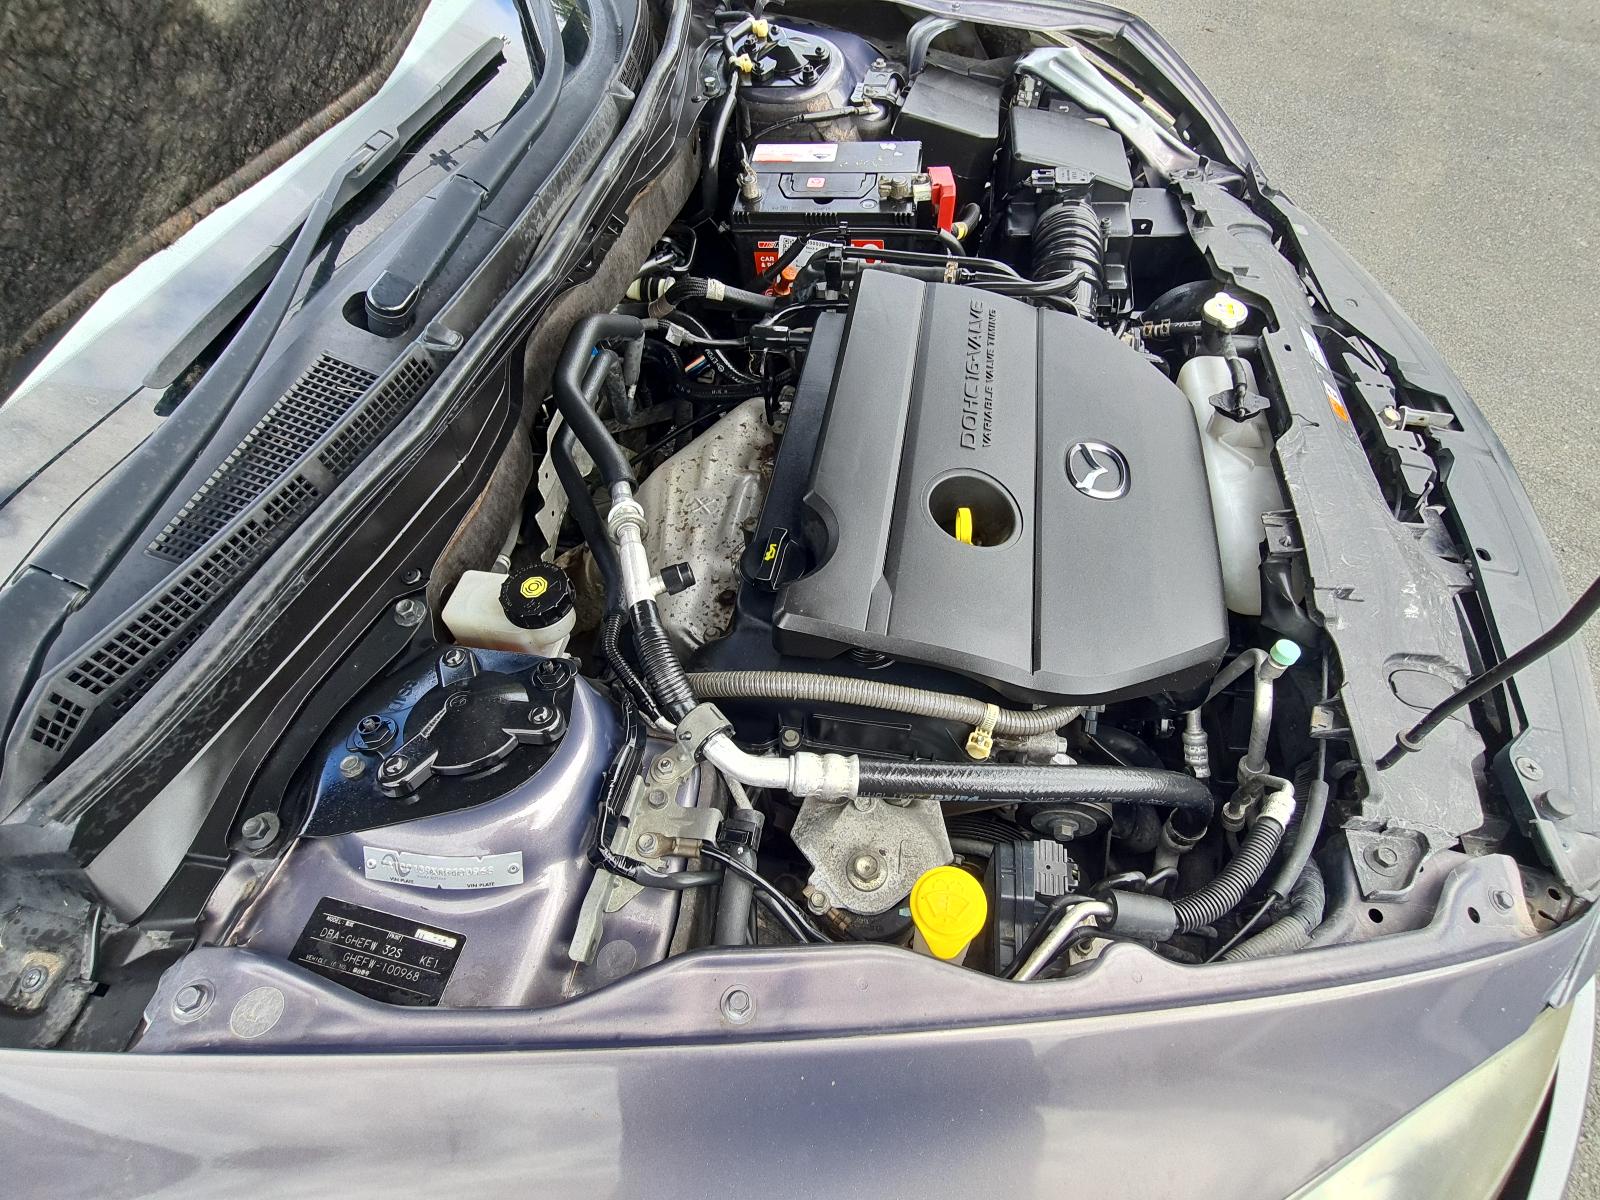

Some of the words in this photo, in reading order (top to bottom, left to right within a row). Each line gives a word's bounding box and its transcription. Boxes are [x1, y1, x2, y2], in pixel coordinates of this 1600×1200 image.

[965, 298, 983, 381] 16-VALVE
[987, 309, 997, 346] TIMING
[985, 349, 995, 383] VALVE
[960, 383, 979, 451] DOHC
[982, 386, 994, 448] VARIABLE
[319, 927, 378, 951] DBA-GHEFW
[382, 944, 403, 958] 32S
[342, 952, 419, 982] GHEFW-100968
